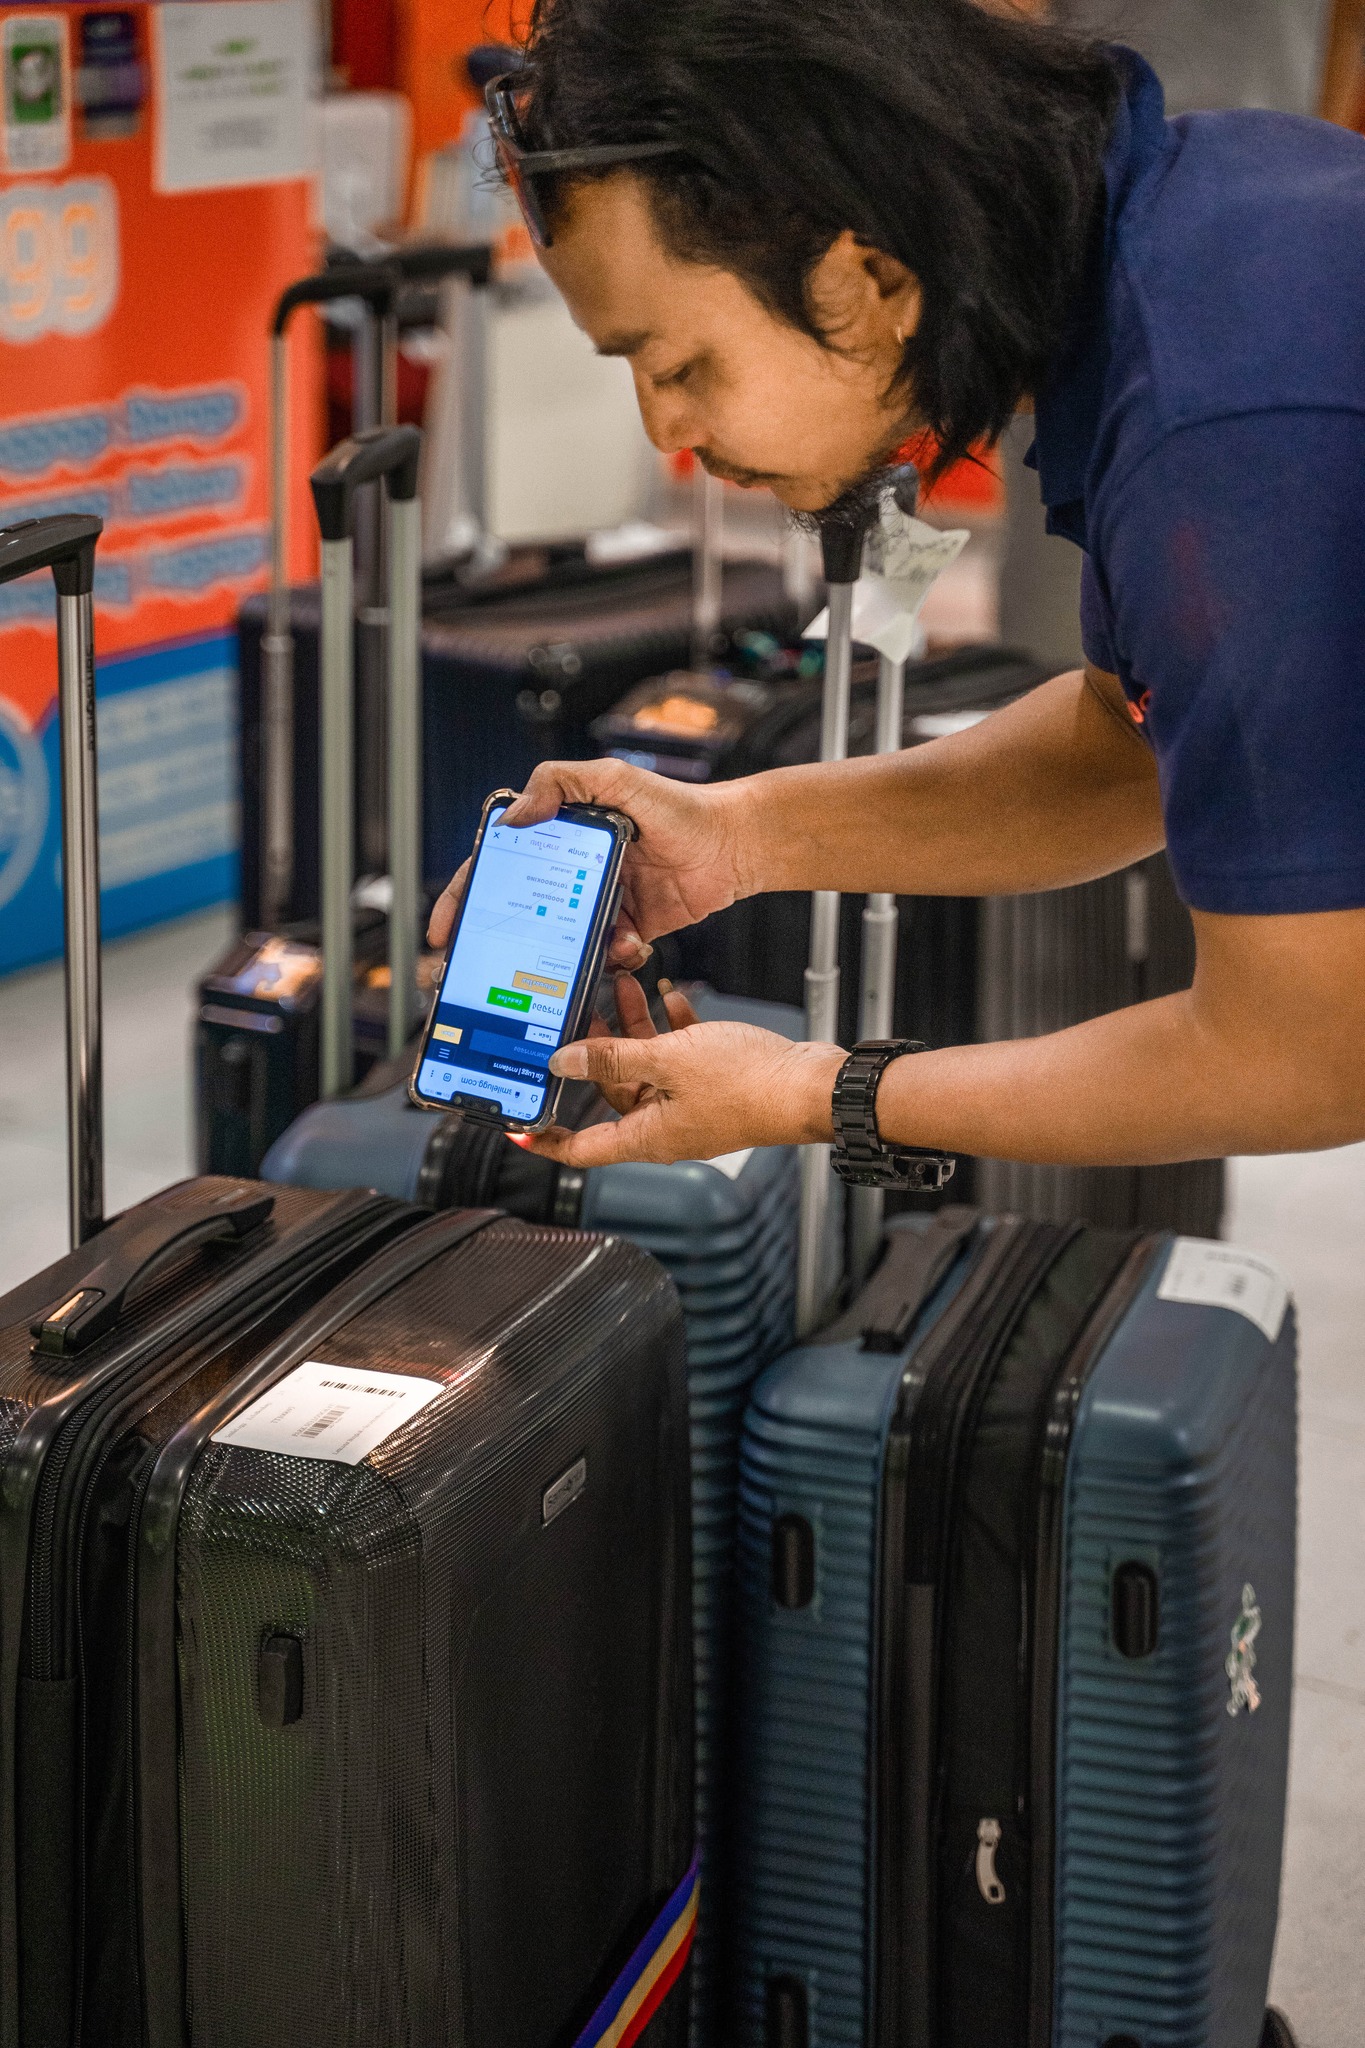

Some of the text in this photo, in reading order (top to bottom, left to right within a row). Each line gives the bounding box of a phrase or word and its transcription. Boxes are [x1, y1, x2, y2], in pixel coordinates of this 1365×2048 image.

[529, 839, 560, 851] ภาษาไทย
[526, 875, 568, 890] TOTOBOOKING
[532, 891, 565, 904] GOODLUGG
[531, 1002, 563, 1017] การจอง
[520, 1068, 536, 1079] Lugg
